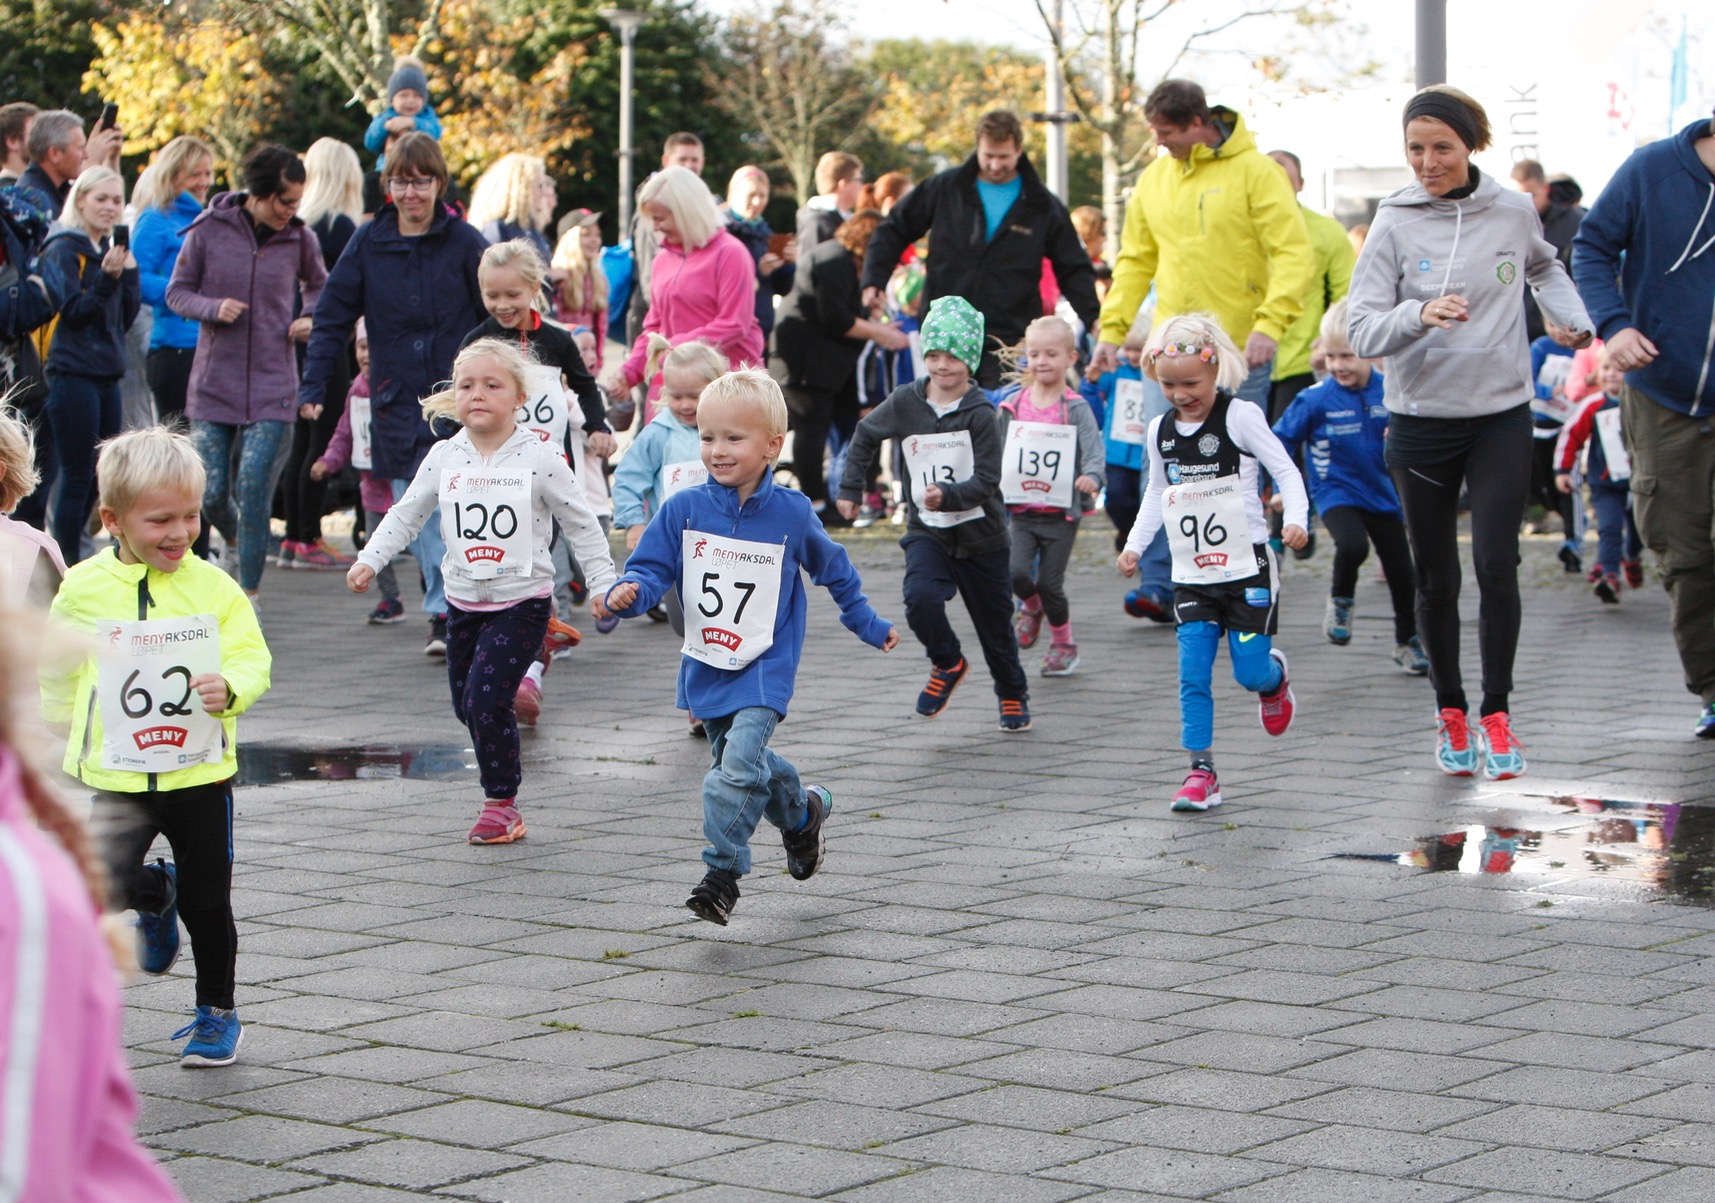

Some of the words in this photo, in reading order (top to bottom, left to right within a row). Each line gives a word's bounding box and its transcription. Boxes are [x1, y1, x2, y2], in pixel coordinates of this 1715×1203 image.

[1018, 447, 1061, 481] 139
[1179, 462, 1220, 474] Haugesund
[466, 478, 525, 487] MENYAKSDAL
[1182, 485, 1235, 500] MENYAKSDAL
[454, 502, 518, 541] 120
[1179, 512, 1228, 553] 96
[468, 549, 501, 559] MENY
[712, 547, 776, 566] MENYAKSDAL
[1197, 555, 1226, 567] MENY
[711, 557, 739, 570] LØPET
[698, 572, 756, 625] 57
[131, 628, 210, 646] MENYAKSDAL
[704, 630, 738, 647] MENY
[131, 644, 166, 657] LØPET
[120, 665, 193, 719] 62
[138, 730, 184, 745] MENY
